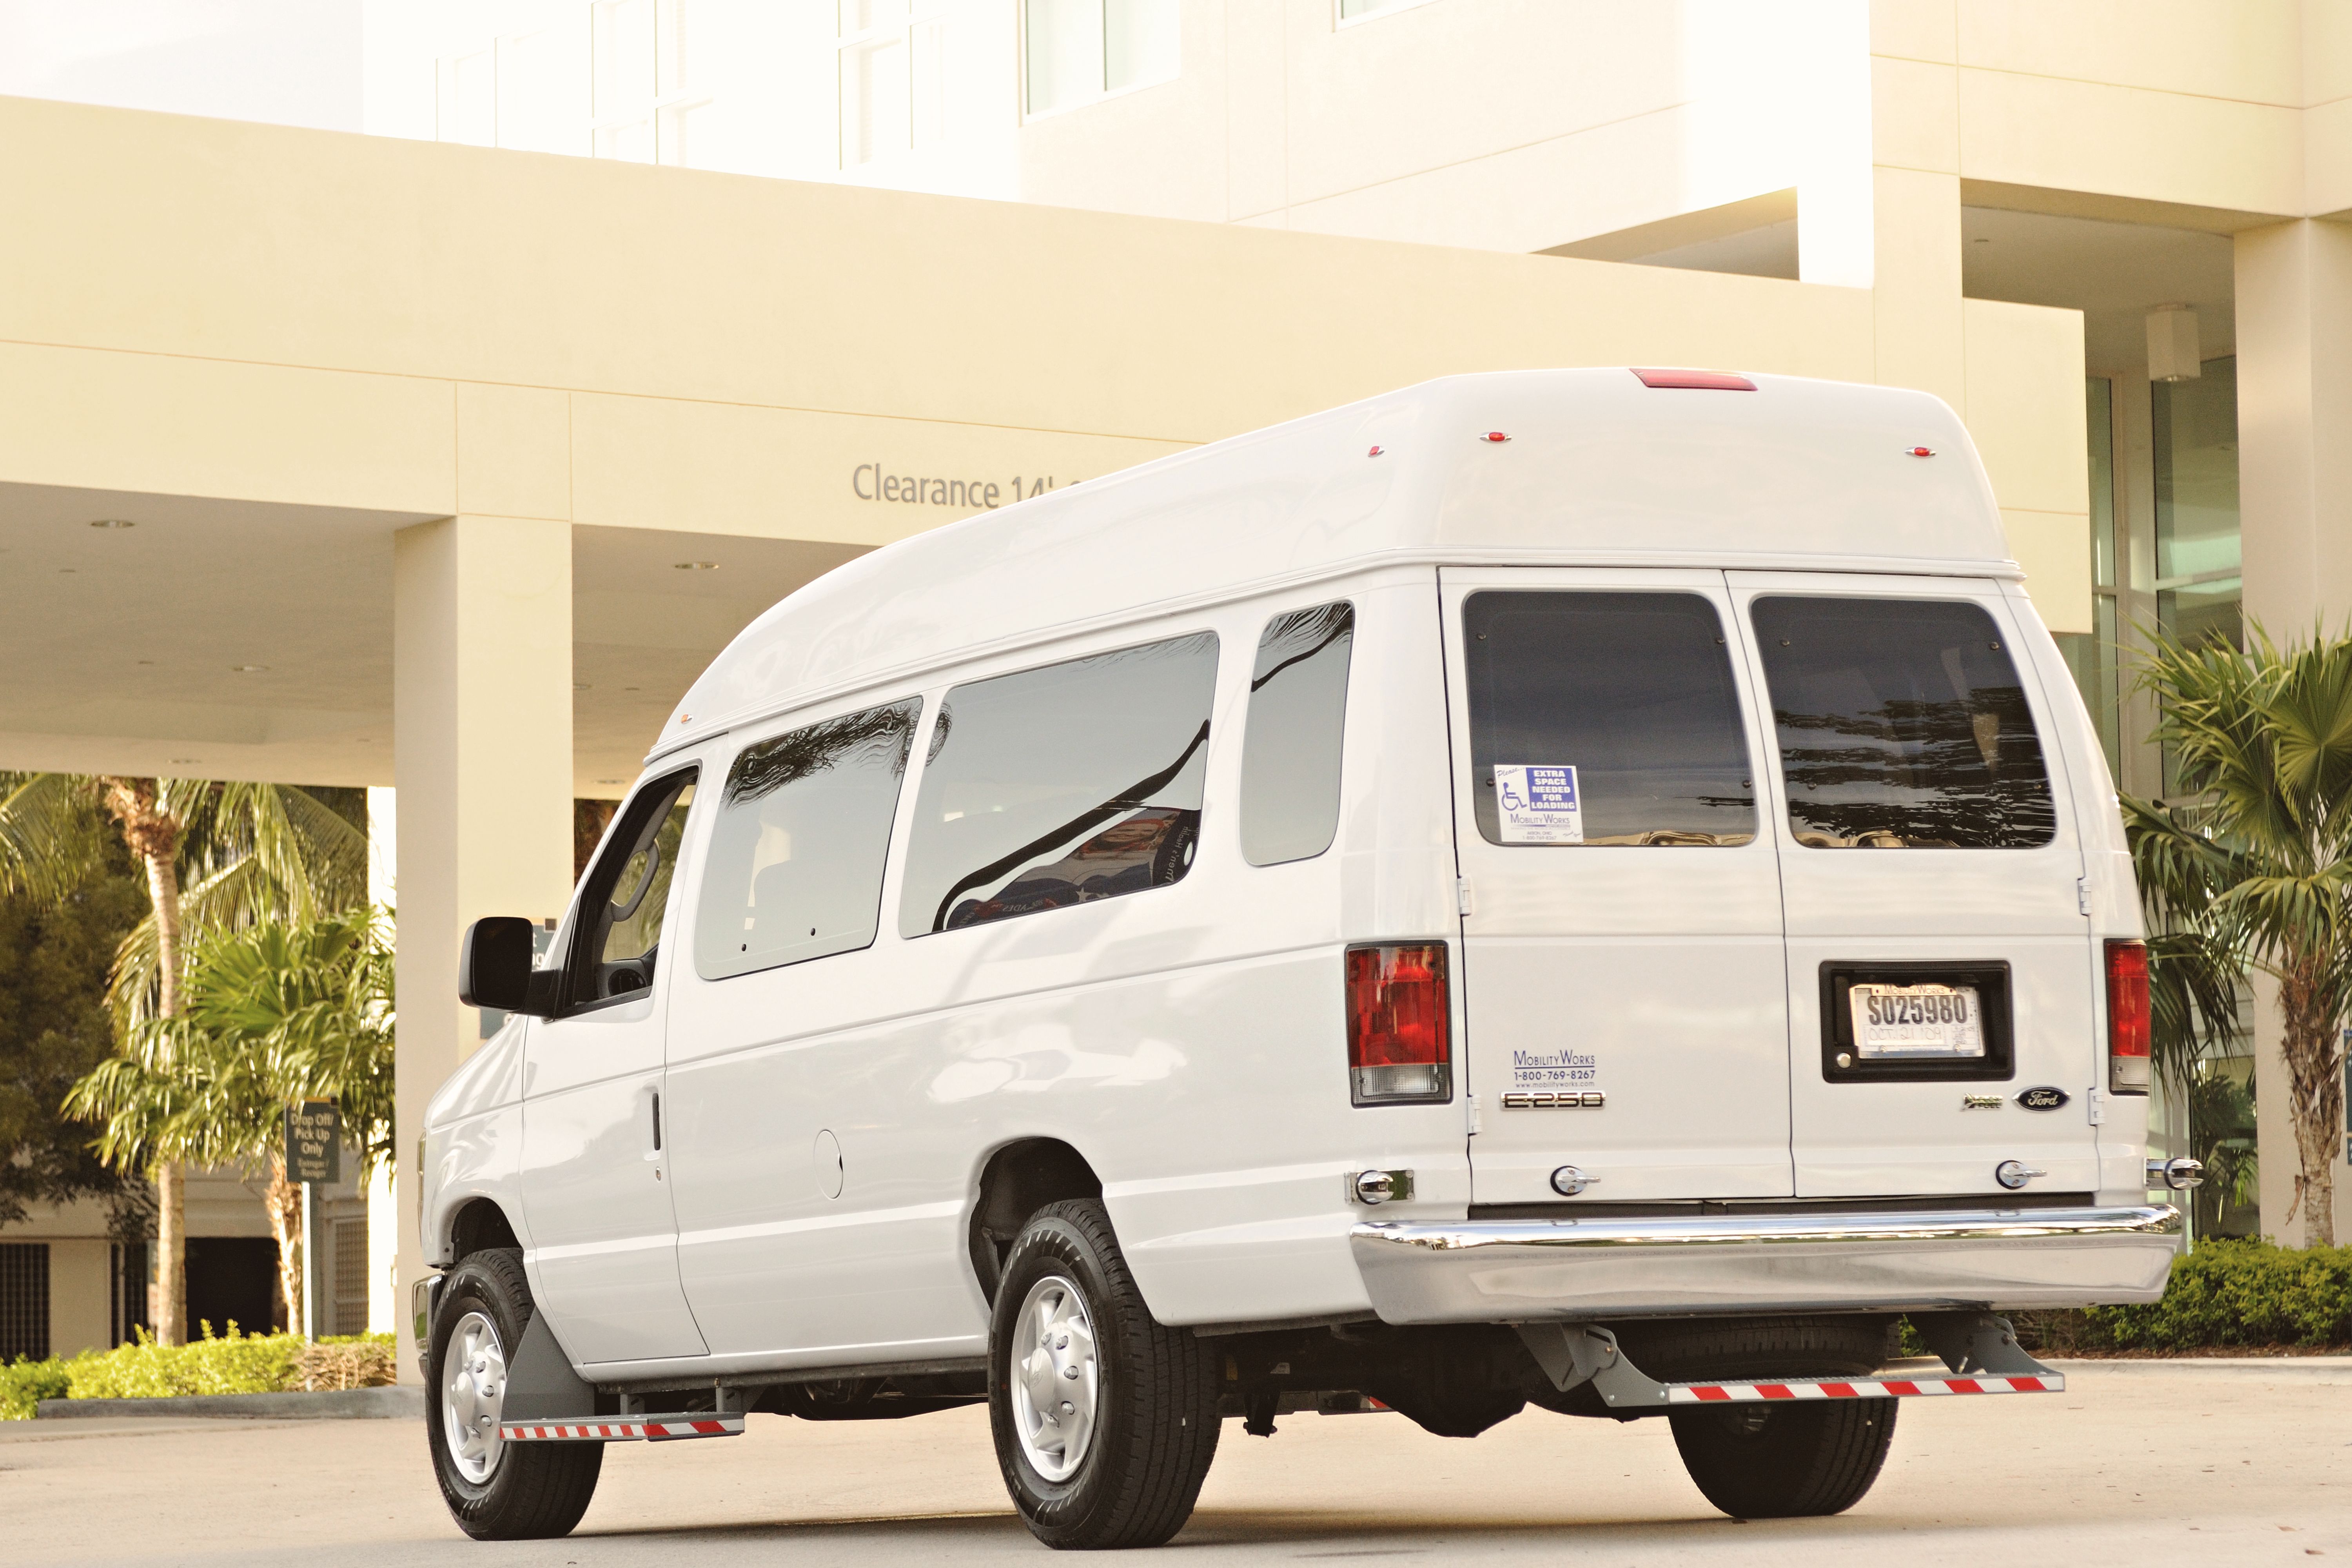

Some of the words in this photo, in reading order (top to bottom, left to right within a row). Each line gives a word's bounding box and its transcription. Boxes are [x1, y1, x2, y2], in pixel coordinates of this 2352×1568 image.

[853, 463, 999, 509] Clearance
[1867, 994, 1968, 1025] S025980
[1900, 1027, 1915, 1040] 21
[1514, 1070, 1596, 1081] 1-800-769-8267
[1504, 1092, 1603, 1108] E250
[2027, 1091, 2058, 1106] Ford
[294, 1127, 314, 1140] Pick
[315, 1127, 330, 1143] Up
[301, 1142, 324, 1158] Only
